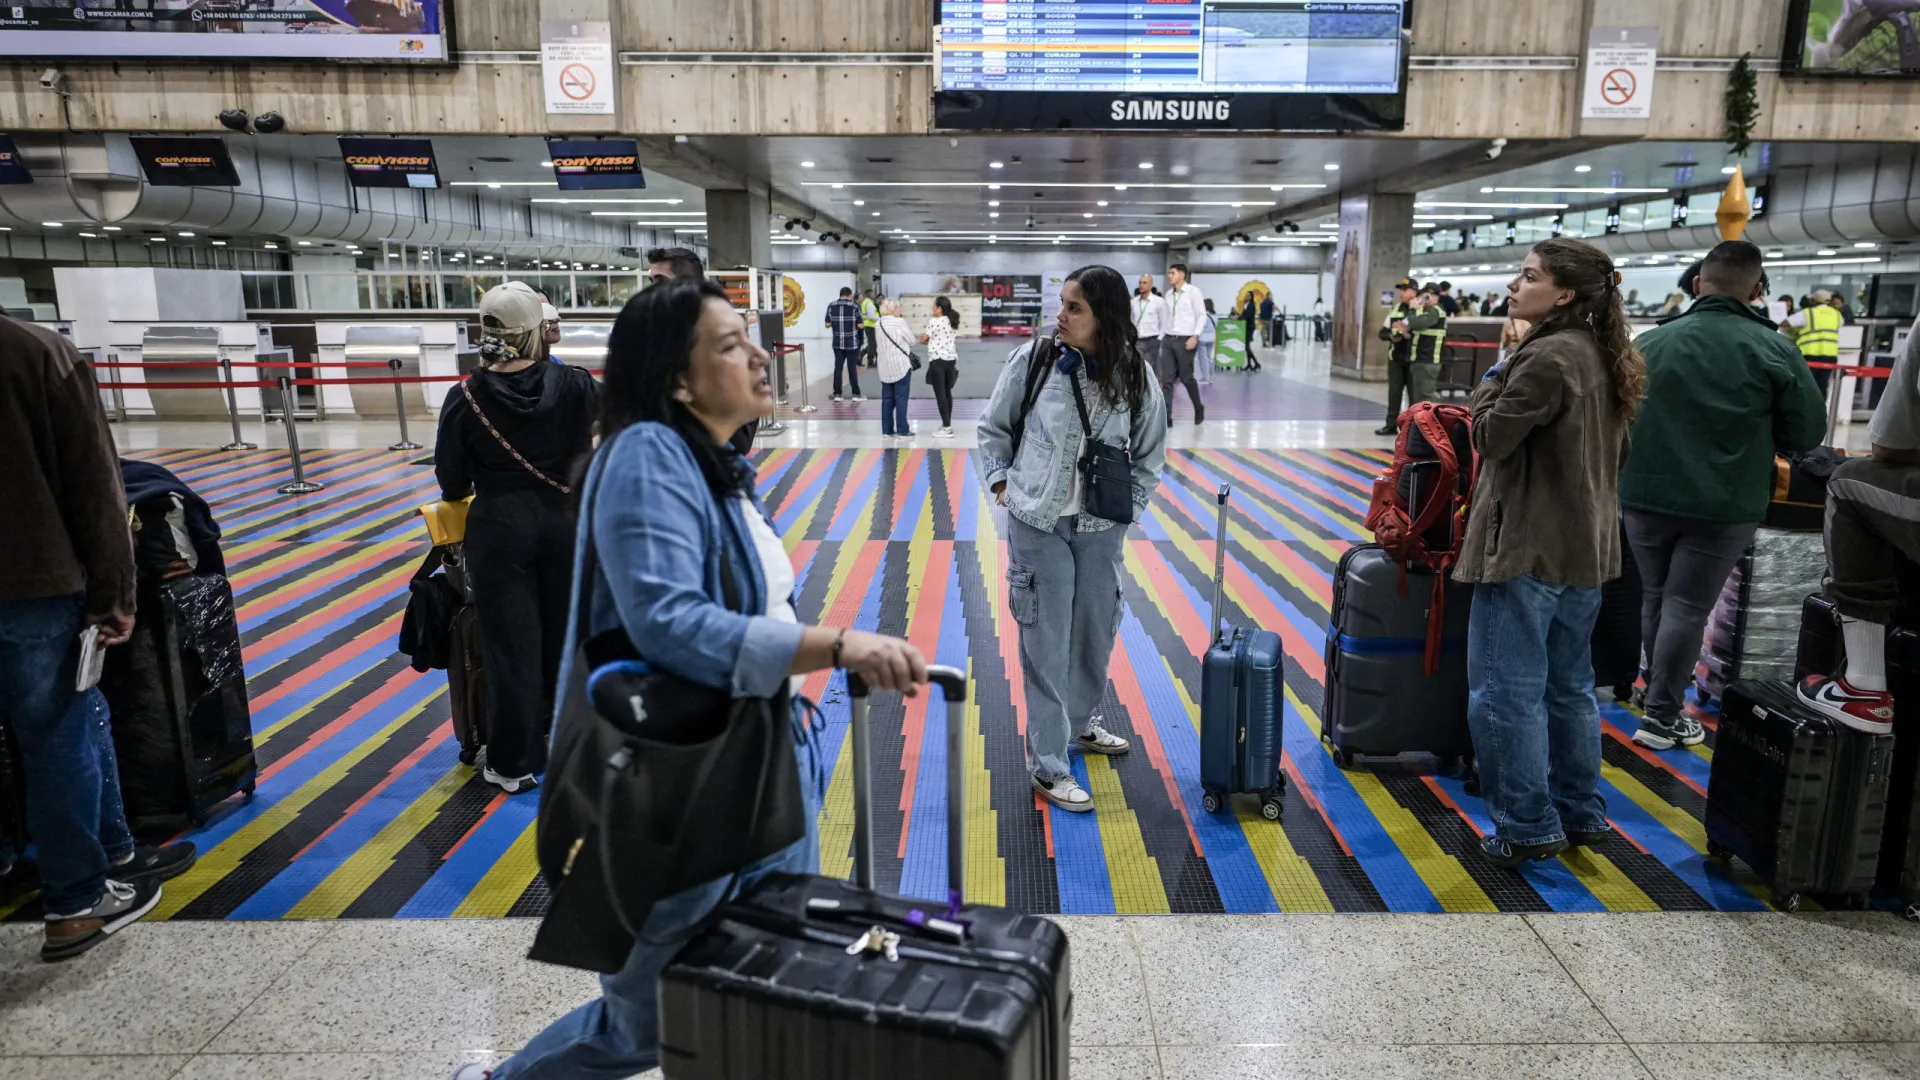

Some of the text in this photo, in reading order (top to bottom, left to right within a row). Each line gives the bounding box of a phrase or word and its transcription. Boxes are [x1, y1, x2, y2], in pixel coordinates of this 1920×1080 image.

[87, 10, 154, 18] WWW.OCAMAR.COM.VE
[1111, 100, 1230, 121] SAMSUNG
[346, 154, 430, 165] conviasa
[552, 156, 636, 166] conviasa
[983, 284, 1011, 297] LDI
